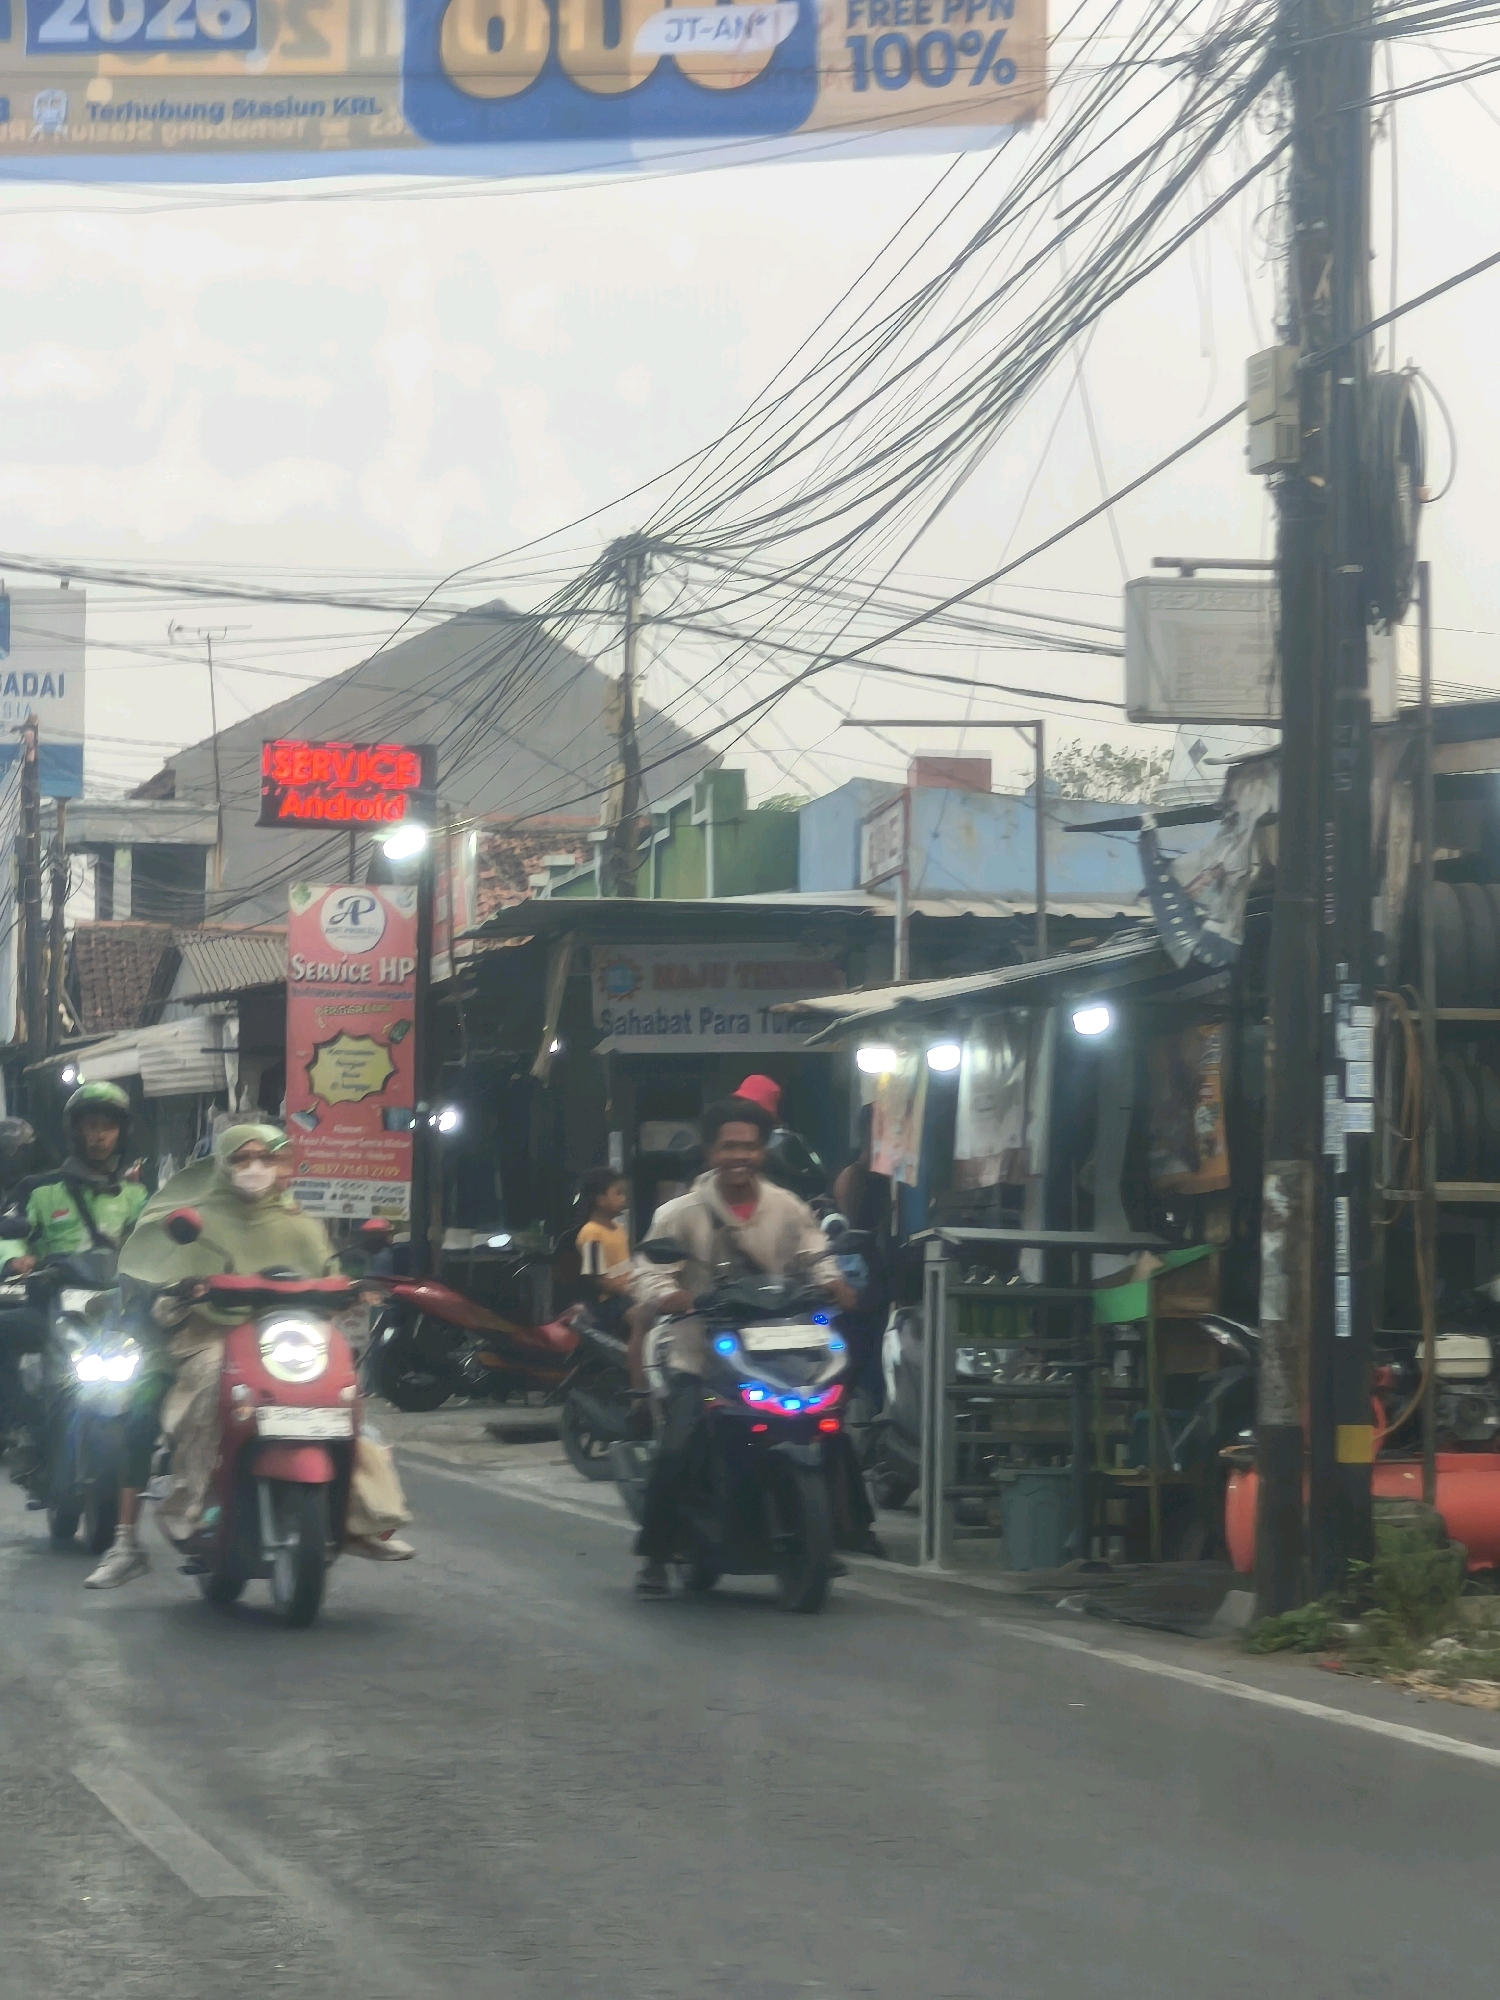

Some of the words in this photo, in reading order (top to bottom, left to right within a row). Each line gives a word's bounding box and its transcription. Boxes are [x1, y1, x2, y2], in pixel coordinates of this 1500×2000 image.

[846, 0, 934, 28] FREE
[940, 0, 1015, 23] PPN
[845, 28, 1017, 92] 100%
[86, 99, 225, 124] Terhubung
[232, 99, 326, 119] Stasiun
[333, 96, 382, 116] KRL
[0, 672, 65, 698] ADAI
[272, 748, 416, 785] SERVICE
[279, 791, 405, 822] Android
[379, 956, 415, 984] HP
[600, 1008, 692, 1035] Sahabat
[699, 1007, 751, 1035] Para
